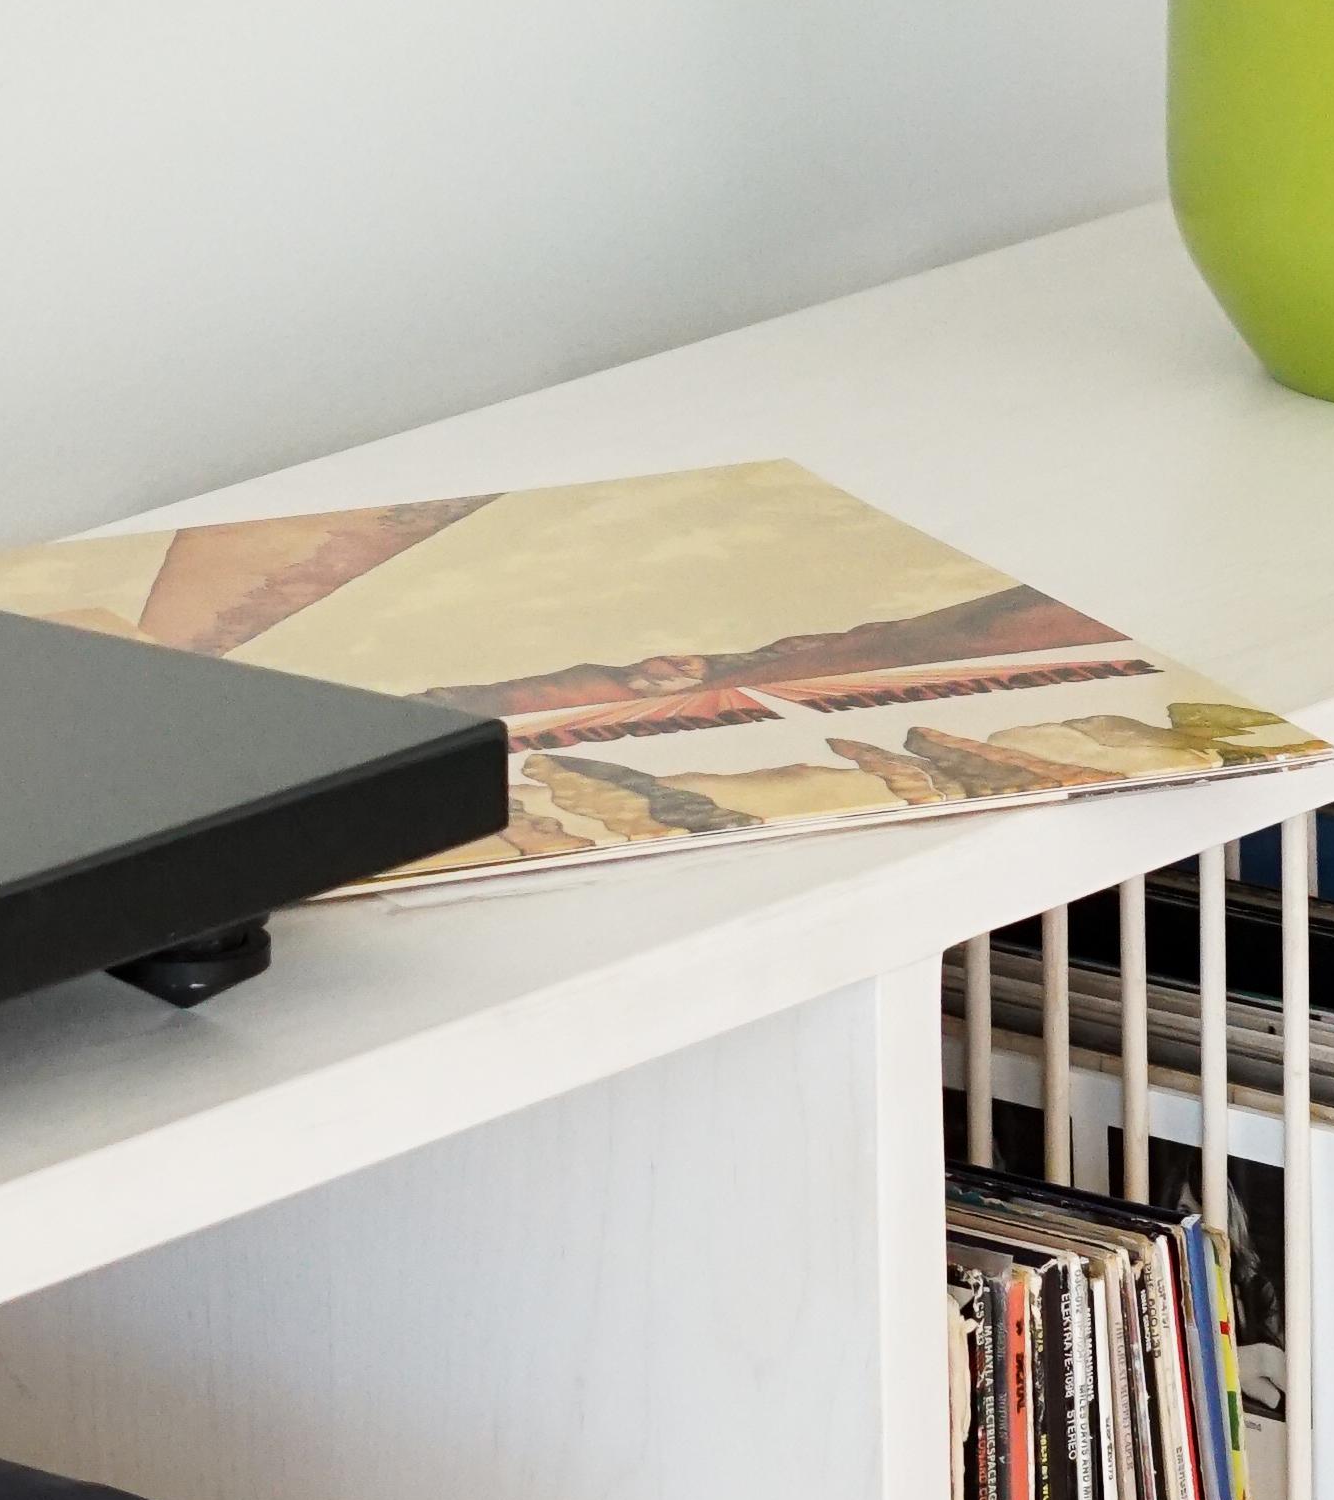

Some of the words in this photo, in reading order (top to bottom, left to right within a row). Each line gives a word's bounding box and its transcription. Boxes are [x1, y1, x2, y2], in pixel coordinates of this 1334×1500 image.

[1073, 1268, 1085, 1316] OJC-012
[1059, 1292, 1074, 1350] ELEKTRA
[1085, 1338, 1096, 1403] MANSIONS
[1116, 1348, 1131, 1392] GREAT
[1077, 1383, 1090, 1422] MILES
[976, 1425, 988, 1485] ONARD
[1039, 1433, 1049, 1464] MEN
[1064, 1409, 1078, 1461] STEREO
[1078, 1423, 1091, 1457] DAVIS
[1122, 1432, 1136, 1472] CAPER
[1080, 1458, 1092, 1482] AND
